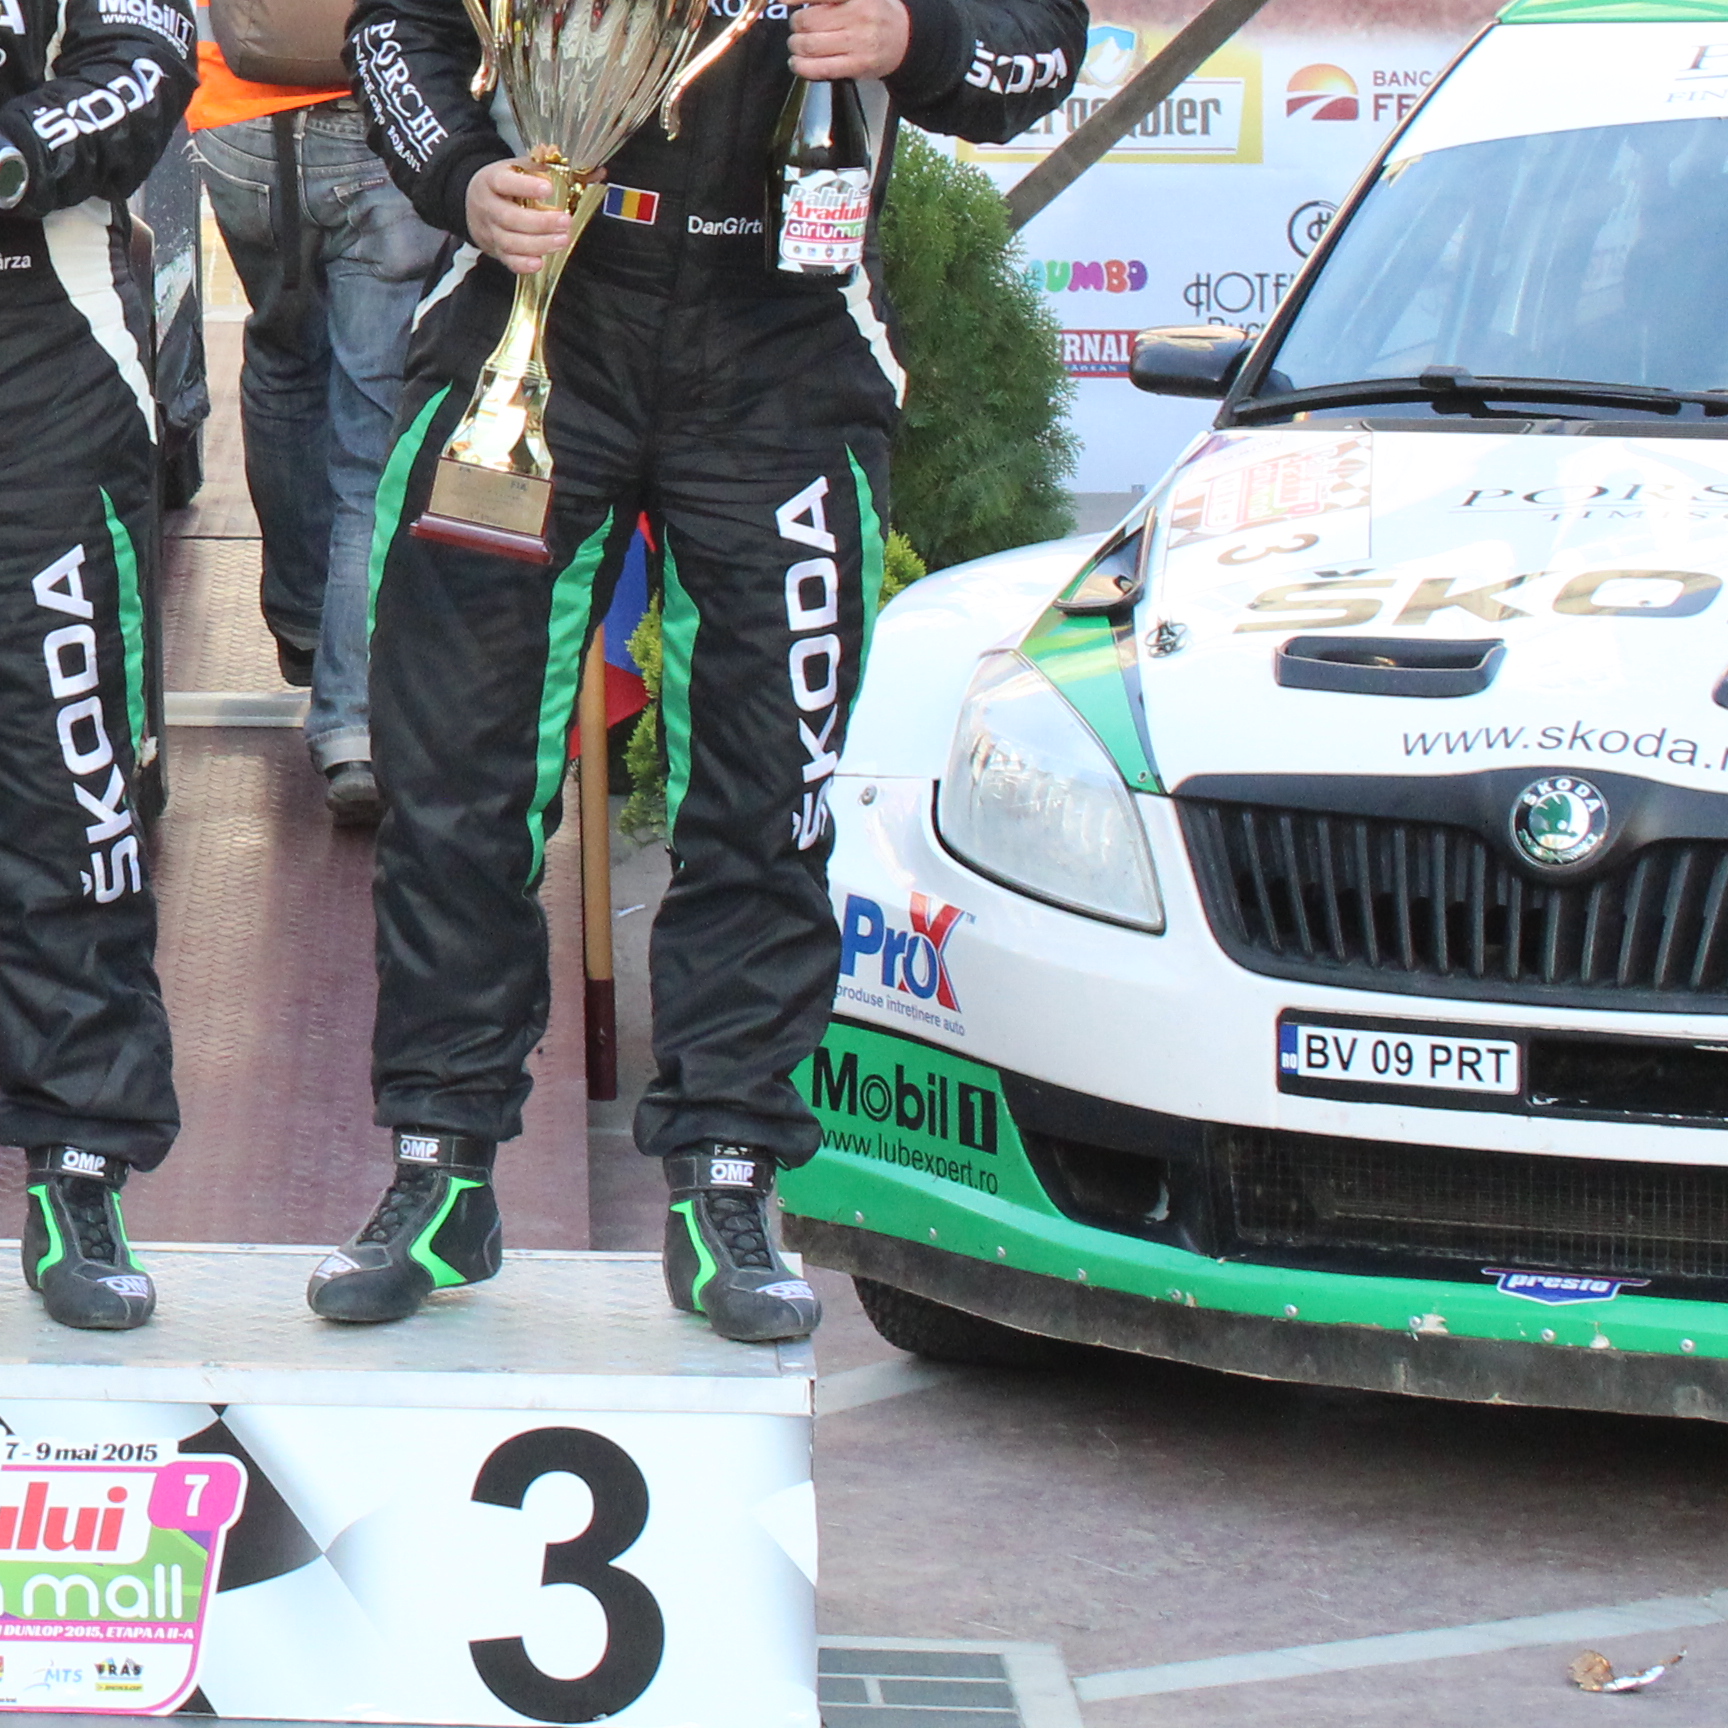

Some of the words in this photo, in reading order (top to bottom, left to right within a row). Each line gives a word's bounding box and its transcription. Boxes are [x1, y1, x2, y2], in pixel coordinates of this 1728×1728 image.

[1217, 532, 1320, 566] 3
[773, 474, 843, 854] ŠKODA
[31, 543, 145, 906] ŠKODA
[835, 985, 883, 1008] produse
[944, 1021, 965, 1037] auto
[1282, 1052, 1297, 1069] RO
[1306, 1034, 1358, 1071] BV
[1372, 1040, 1413, 1075] 09
[1430, 1043, 1510, 1083] PRT
[812, 1046, 948, 1140] Mobil
[61, 1148, 106, 1175] OMP
[399, 1137, 438, 1160] OMP
[821, 1128, 998, 1194] www.lubexpert.ro
[710, 1163, 754, 1186] OMP
[1507, 1273, 1611, 1293] presto
[5, 1442, 18, 1460] 7
[35, 1443, 50, 1460] 9
[54, 1443, 99, 1462] mai
[101, 1444, 158, 1462] 2015
[184, 1474, 210, 1517] 7
[22, 1563, 183, 1619] mall
[468, 1424, 666, 1725] 3
[4, 1625, 63, 1638] DUNLOP
[106, 1627, 153, 1639] ETAPA
[154, 1627, 165, 1639] A
[167, 1627, 194, 1640] II-A
